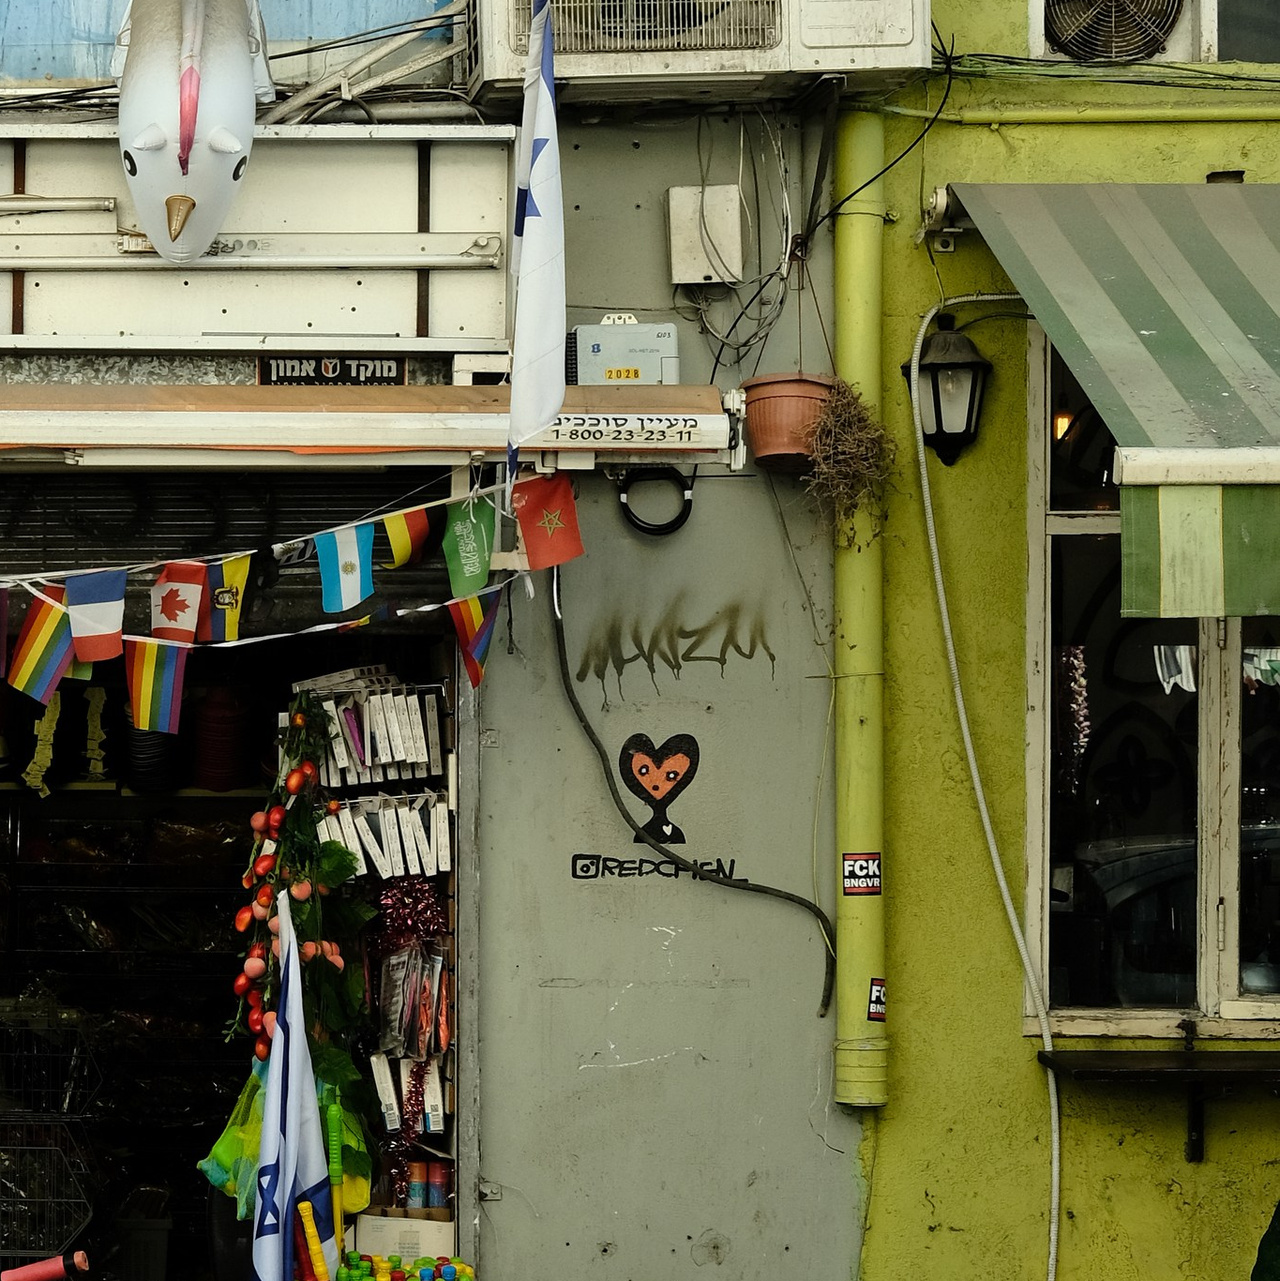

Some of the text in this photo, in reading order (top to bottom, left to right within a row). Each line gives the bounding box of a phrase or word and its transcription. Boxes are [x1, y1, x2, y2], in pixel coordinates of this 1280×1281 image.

[269, 359, 397, 381] מוקד אמון
[607, 369, 640, 380] 2028
[637, 416, 698, 431] מעיין
[551, 429, 692, 441] 1-800-23-23-11
[843, 859, 880, 877] FCK
[843, 877, 880, 888] BNGVR
